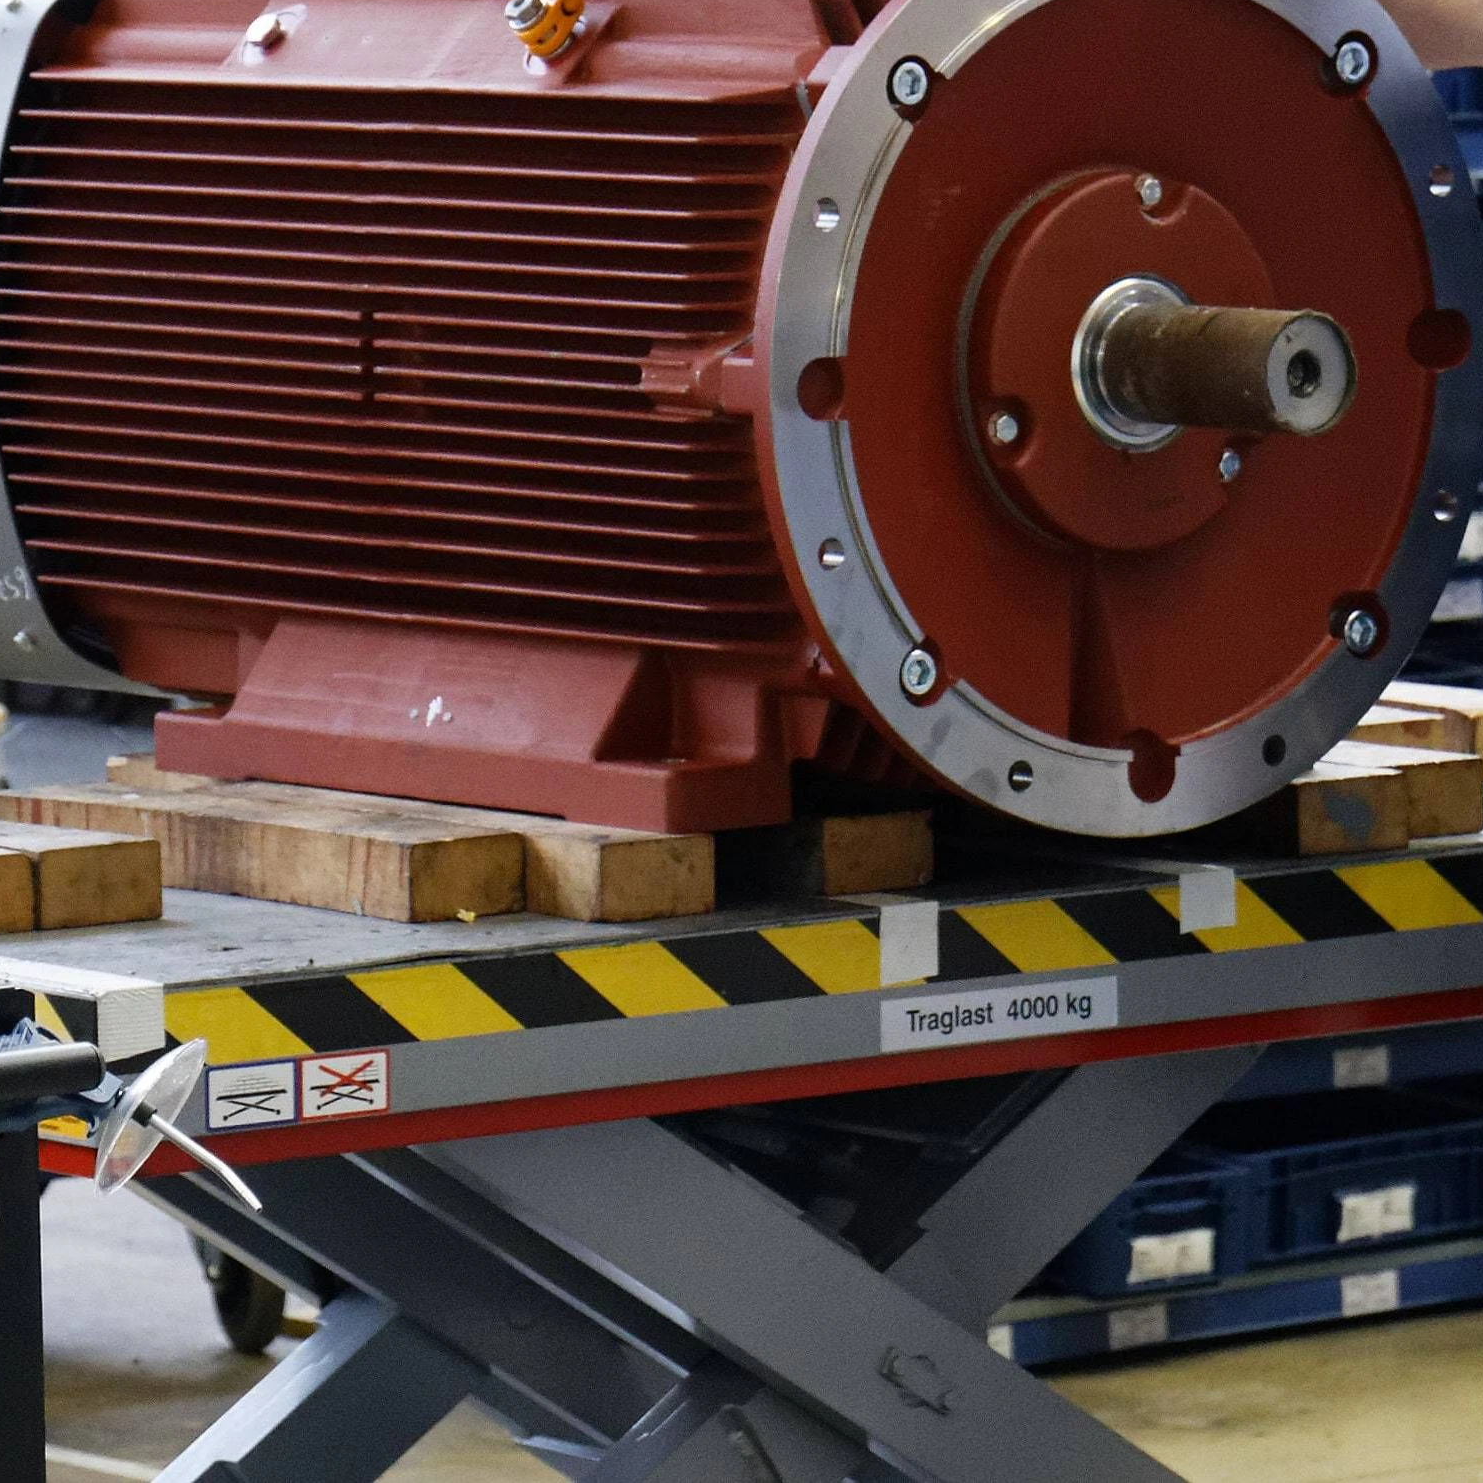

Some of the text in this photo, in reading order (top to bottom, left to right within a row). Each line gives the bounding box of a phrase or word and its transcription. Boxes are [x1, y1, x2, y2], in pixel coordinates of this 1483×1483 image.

[905, 992, 1093, 1035] Traglast 4000 kg
